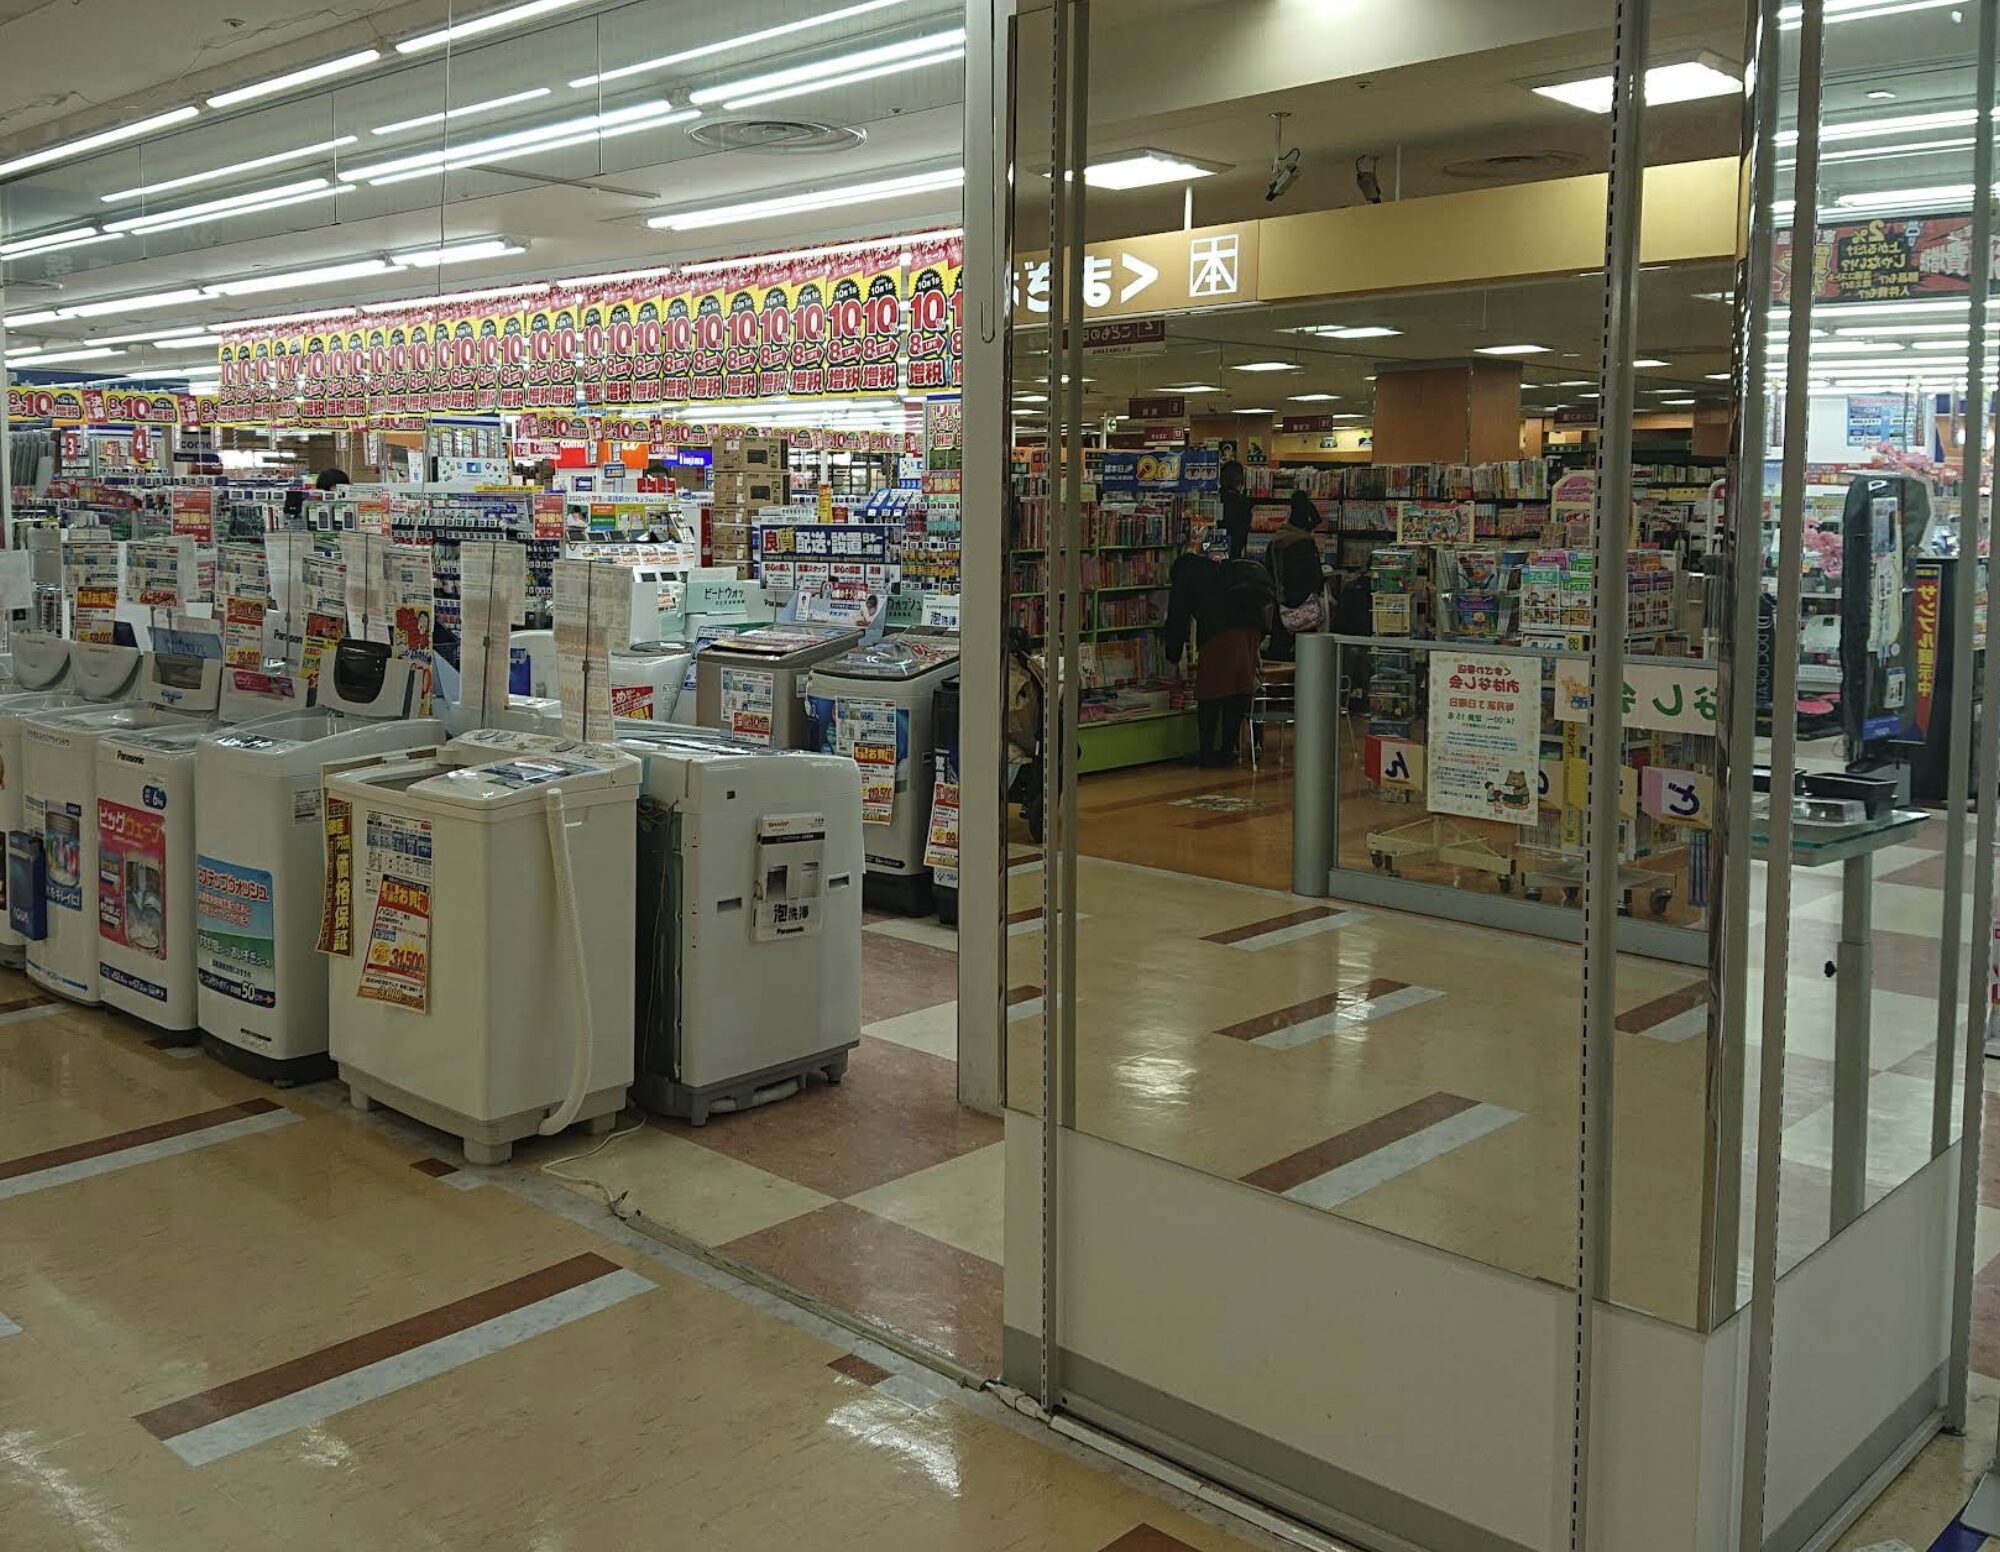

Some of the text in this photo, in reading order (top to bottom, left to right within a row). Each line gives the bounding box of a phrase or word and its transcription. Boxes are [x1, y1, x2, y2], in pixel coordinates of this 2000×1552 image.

[792, 368, 823, 394] 増税
[828, 366, 861, 392] 増税
[862, 362, 896, 389] 増税
[908, 360, 944, 387] 増税
[67, 437, 75, 455] 3
[136, 436, 144, 453] 4
[762, 526, 862, 555] 良質配送・設置
[116, 750, 145, 766] Panasonic
[773, 903, 810, 924] 泡洗浄
